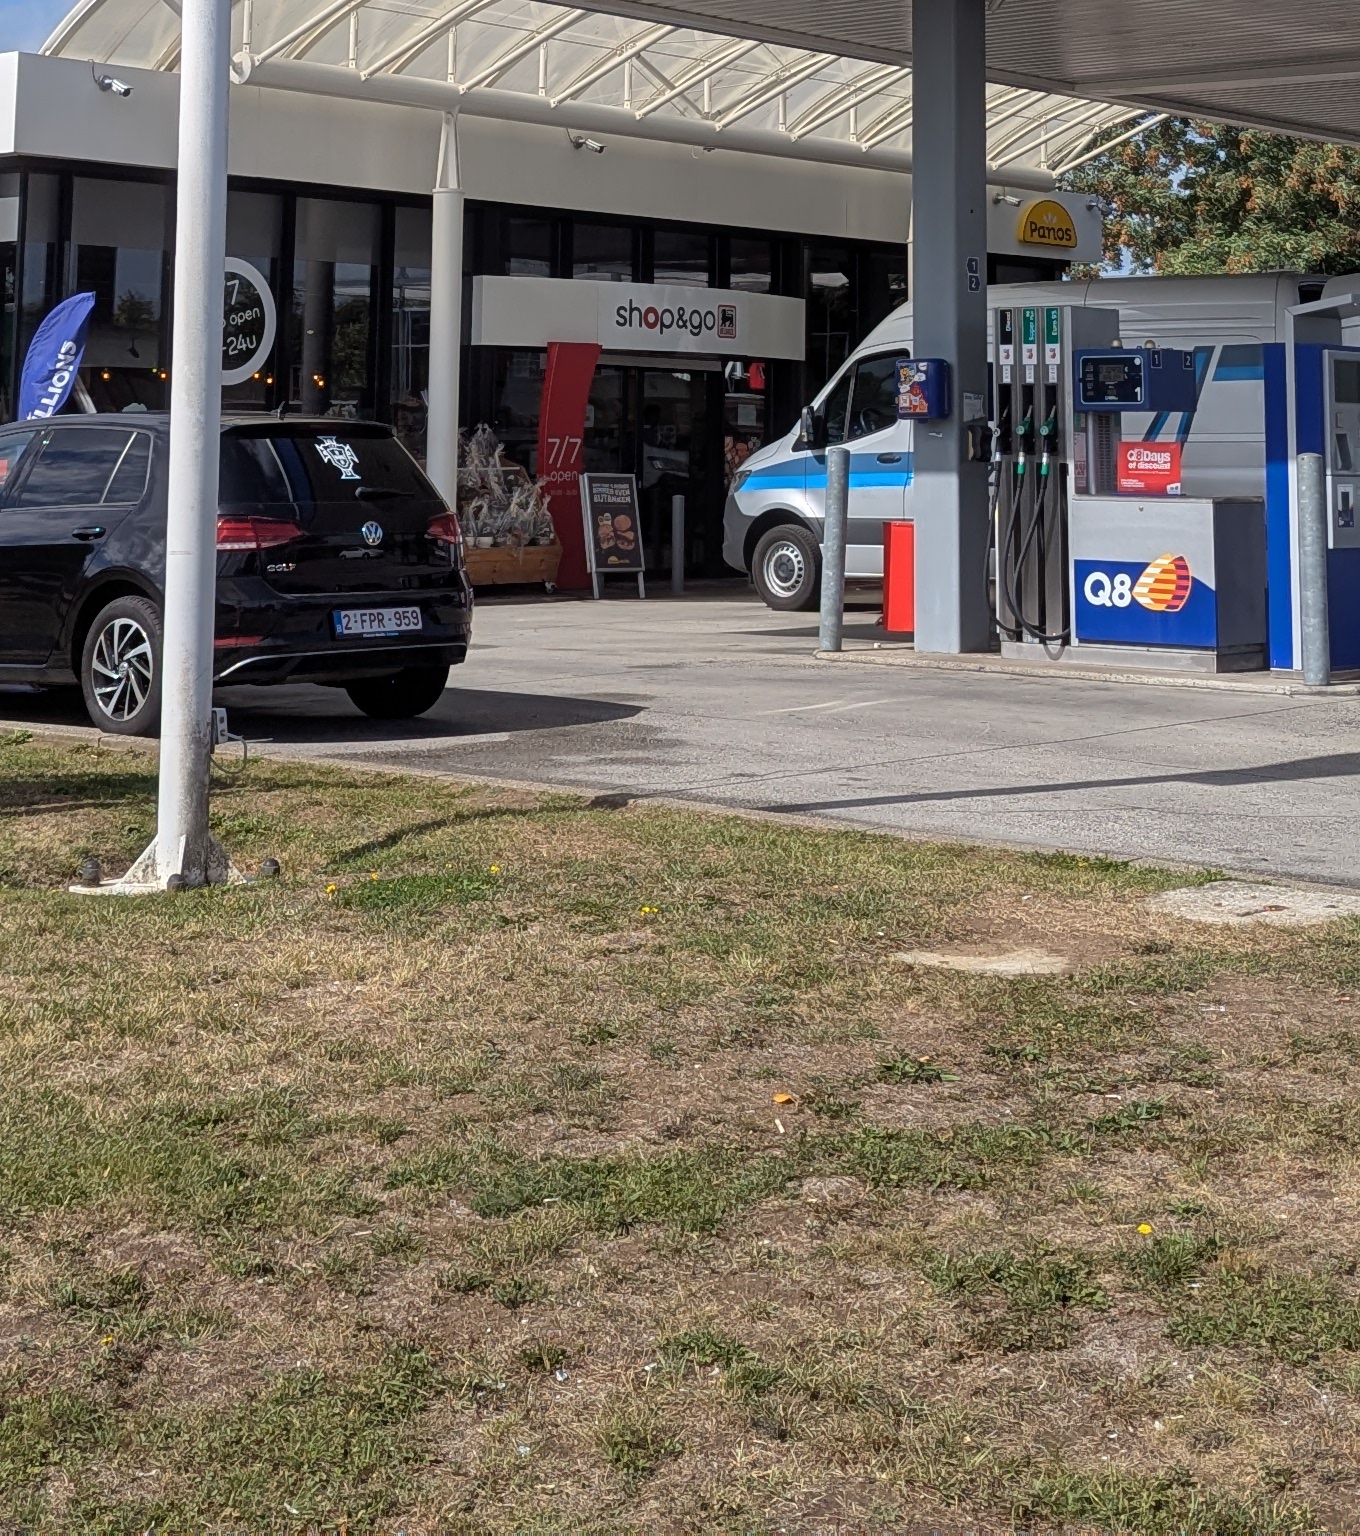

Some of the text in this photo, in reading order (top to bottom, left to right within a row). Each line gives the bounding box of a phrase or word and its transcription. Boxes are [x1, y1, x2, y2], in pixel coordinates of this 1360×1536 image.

[1029, 220, 1072, 242] Panos
[229, 307, 260, 326] open
[615, 298, 716, 337] shop&go
[1134, 386, 1141, 401] 1
[547, 436, 581, 468] 7/7
[550, 470, 578, 483] open
[267, 563, 296, 572] GOLF
[1084, 571, 1132, 608] Q8
